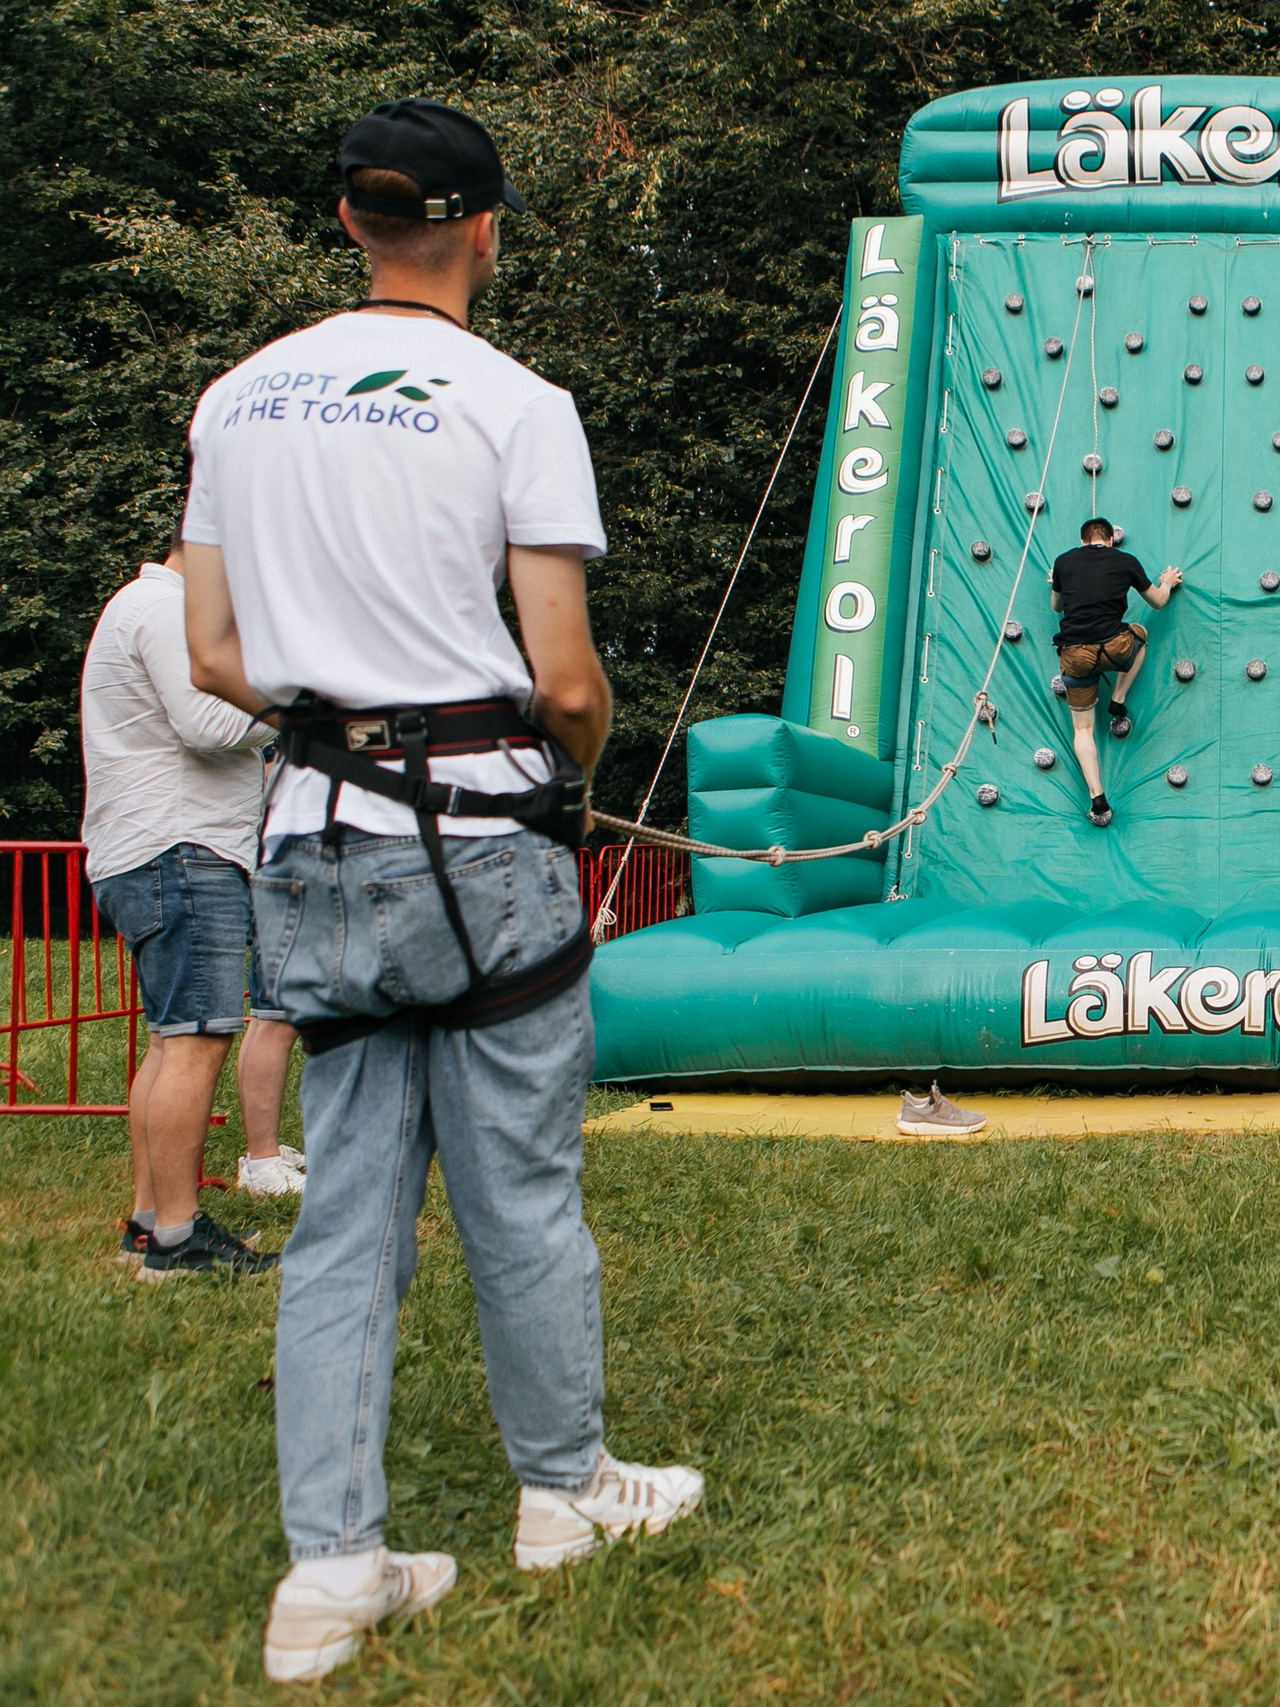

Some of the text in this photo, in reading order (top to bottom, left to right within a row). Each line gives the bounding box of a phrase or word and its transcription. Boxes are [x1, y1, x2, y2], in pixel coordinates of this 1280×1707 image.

[235, 371, 338, 401] СПОРТ
[223, 398, 440, 433] И НЕ ТОЛЬКО
[824, 223, 904, 722] Läkerol
